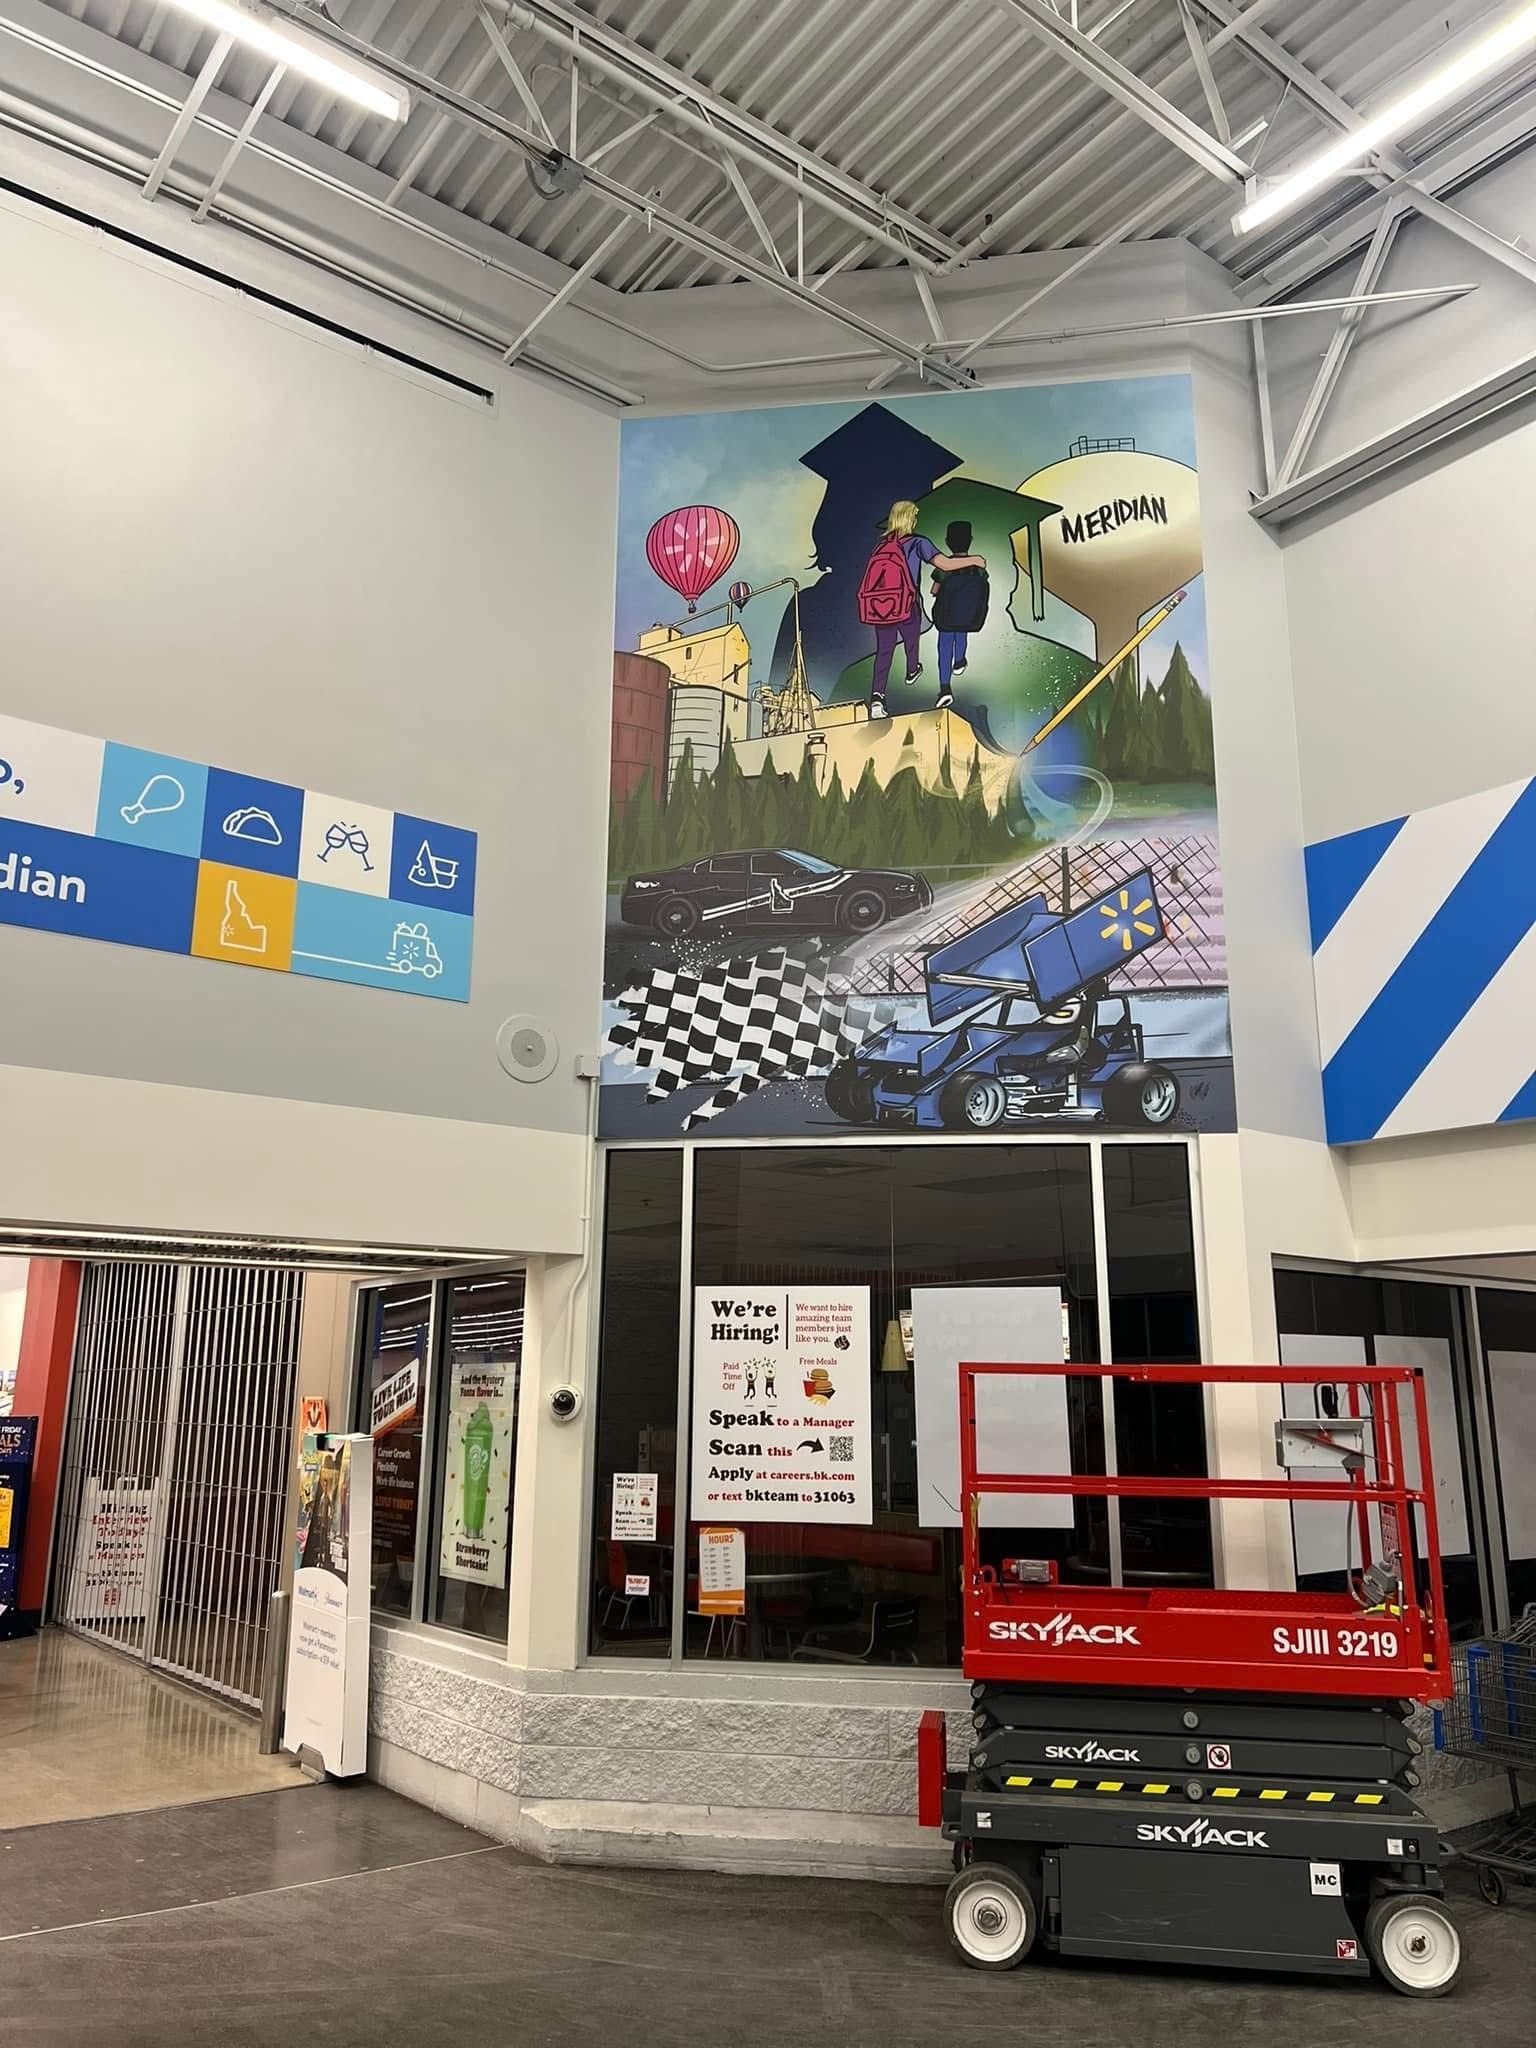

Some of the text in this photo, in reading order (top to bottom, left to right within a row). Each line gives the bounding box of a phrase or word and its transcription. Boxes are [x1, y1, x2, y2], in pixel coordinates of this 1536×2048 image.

[1060, 494, 1168, 544] MERIDIAN
[711, 1300, 777, 1317] We're
[795, 1303, 853, 1312] We want to hire
[795, 1314, 852, 1323] amazing team
[710, 1324, 779, 1344] Hiring!
[795, 1324, 851, 1333] members just
[795, 1334, 831, 1344] like you.
[723, 1362, 739, 1370] Paid
[799, 1357, 815, 1365] Free
[373, 1369, 411, 1410] LIVE LIFE
[722, 1382, 735, 1390] Off
[373, 1399, 395, 1426] YOUR
[709, 1409, 775, 1429] Speak
[777, 1418, 789, 1426] to
[803, 1417, 855, 1429] Manager
[709, 1439, 793, 1456] Scan this
[708, 1466, 754, 1481] Apply
[770, 1471, 855, 1481] careers.bk.com
[722, 1492, 742, 1501] text
[745, 1489, 799, 1502] bkteam
[802, 1494, 812, 1502] to
[814, 1491, 855, 1504] 31063
[708, 1534, 734, 1544] HOURS
[988, 1613, 1142, 1647] SKYJACK
[1273, 1627, 1398, 1658] SJIII 3219
[1045, 1740, 1141, 1763] SKYJACK
[1136, 1818, 1270, 1848] SKYJACK
[1314, 1874, 1337, 1886] MC
